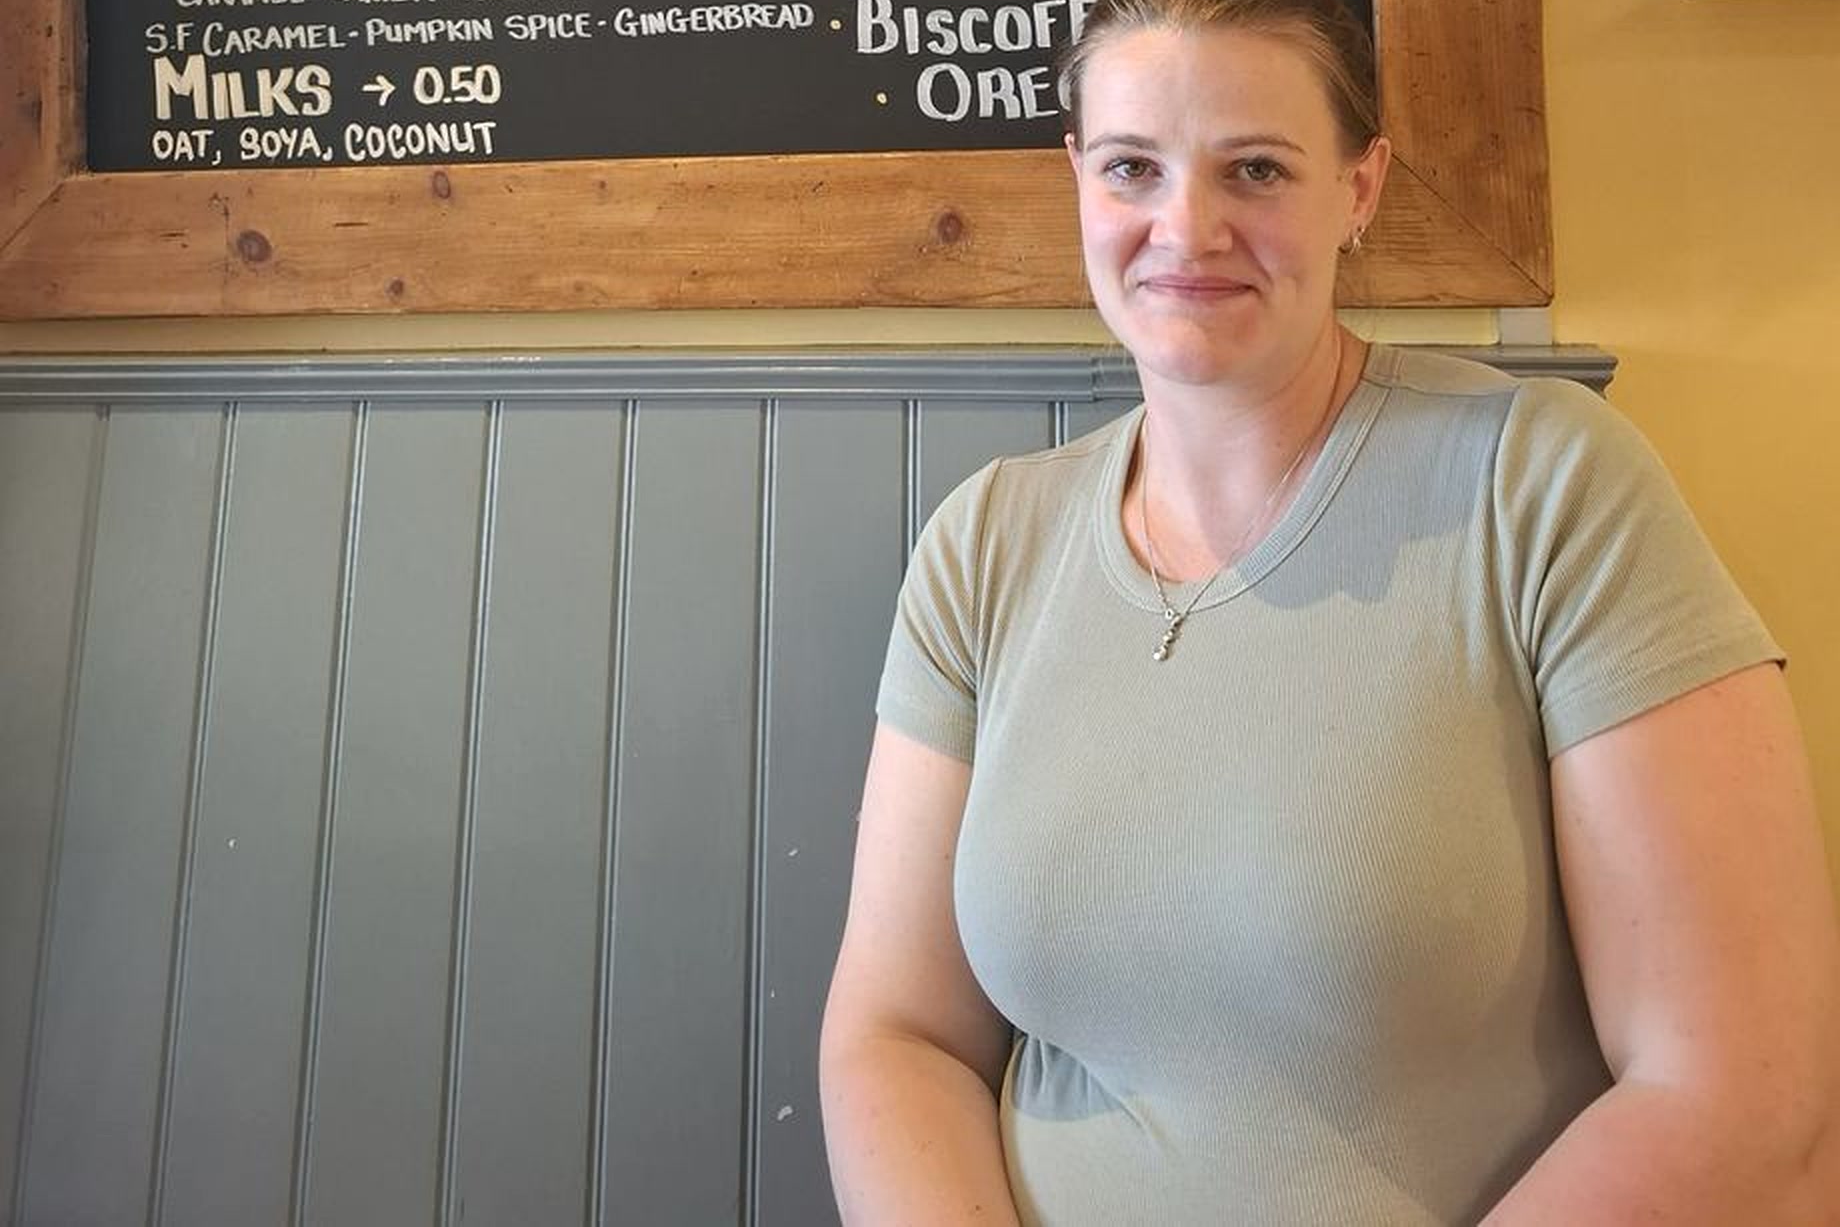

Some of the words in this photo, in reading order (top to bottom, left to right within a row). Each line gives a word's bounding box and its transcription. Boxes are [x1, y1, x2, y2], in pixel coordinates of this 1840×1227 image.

[365, 17, 494, 45] PUMPKIN
[504, 13, 593, 42] SPICE
[613, 3, 815, 37] GINGERBREAD
[153, 53, 332, 121] MILKS
[413, 64, 502, 105] 0.50
[917, 63, 1072, 122] ORE
[152, 129, 222, 165] OAT,
[239, 127, 332, 161] SOYA,
[344, 121, 497, 159] COCONUT
